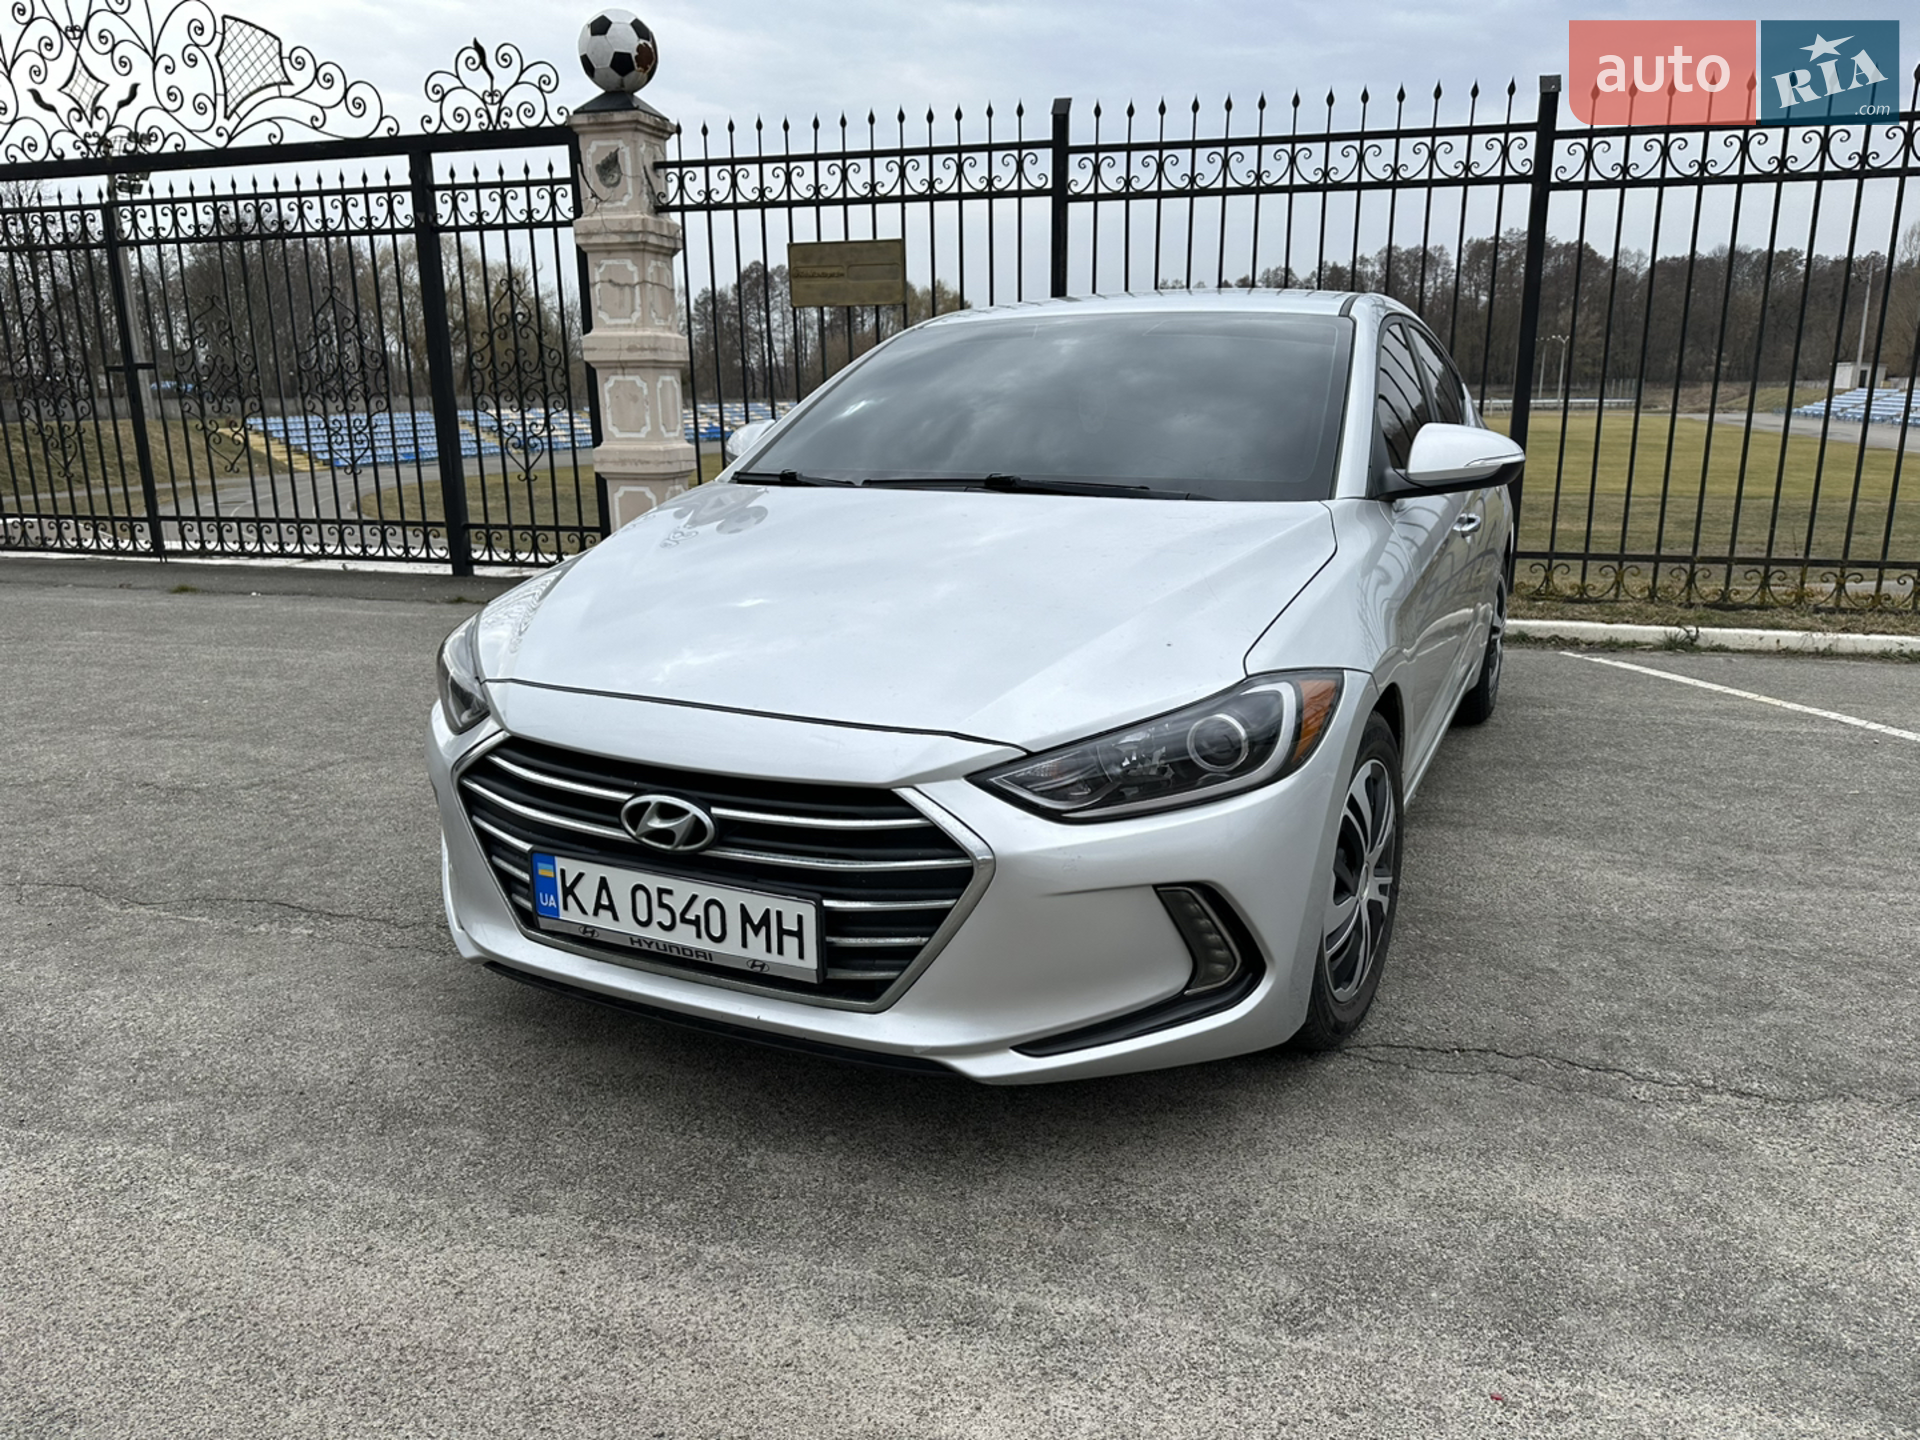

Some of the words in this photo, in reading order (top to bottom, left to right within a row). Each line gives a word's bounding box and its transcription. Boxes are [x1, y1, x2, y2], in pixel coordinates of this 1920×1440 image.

[539, 892, 558, 909] UA
[559, 867, 620, 922] KA
[630, 883, 727, 944] 0540
[739, 902, 805, 961] MH
[629, 936, 714, 962] HYUNDAI
